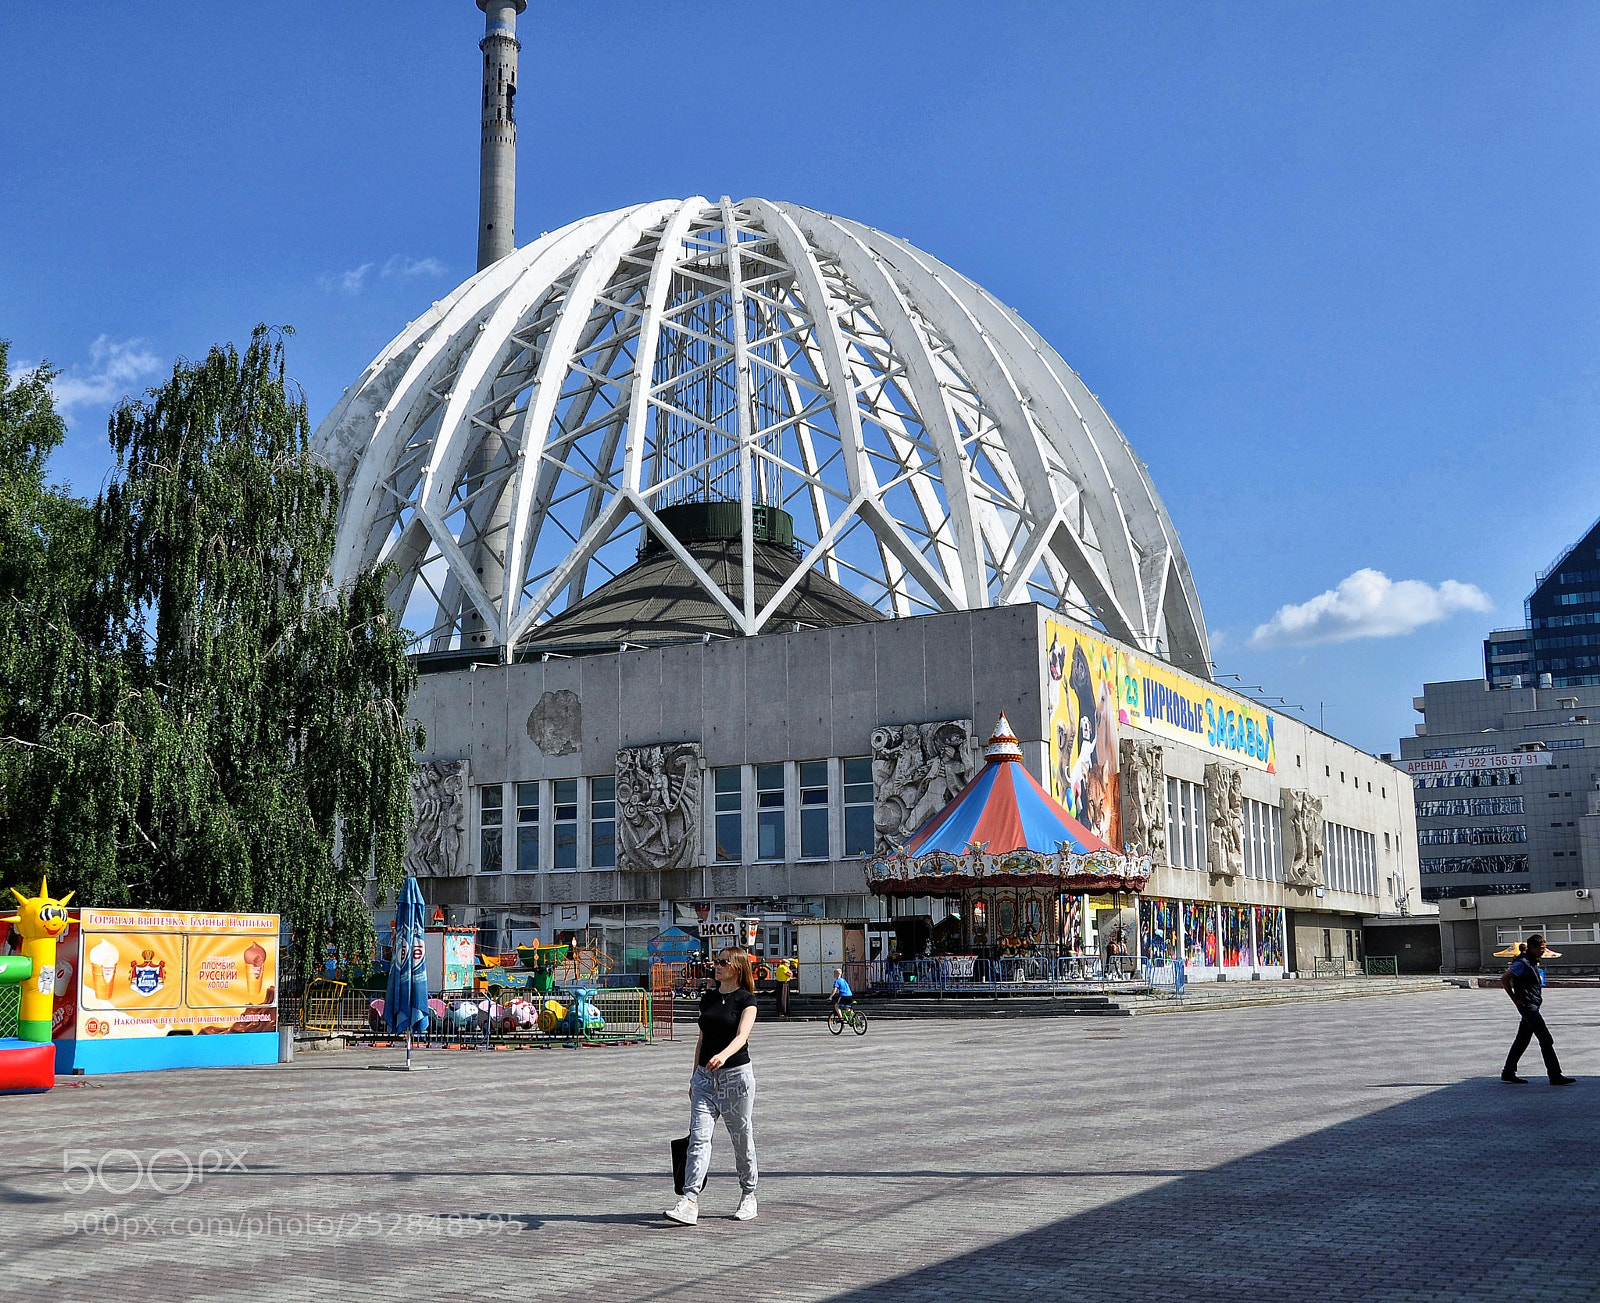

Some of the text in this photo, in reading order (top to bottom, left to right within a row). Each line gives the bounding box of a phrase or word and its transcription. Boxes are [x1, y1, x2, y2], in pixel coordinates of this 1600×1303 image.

[1125, 675, 1139, 708] 23
[1142, 677, 1270, 763] ЦИРКОВЫЕ ЗАБАВЫ
[1408, 754, 1539, 772] АРЕНДА +7 922 156 57 91
